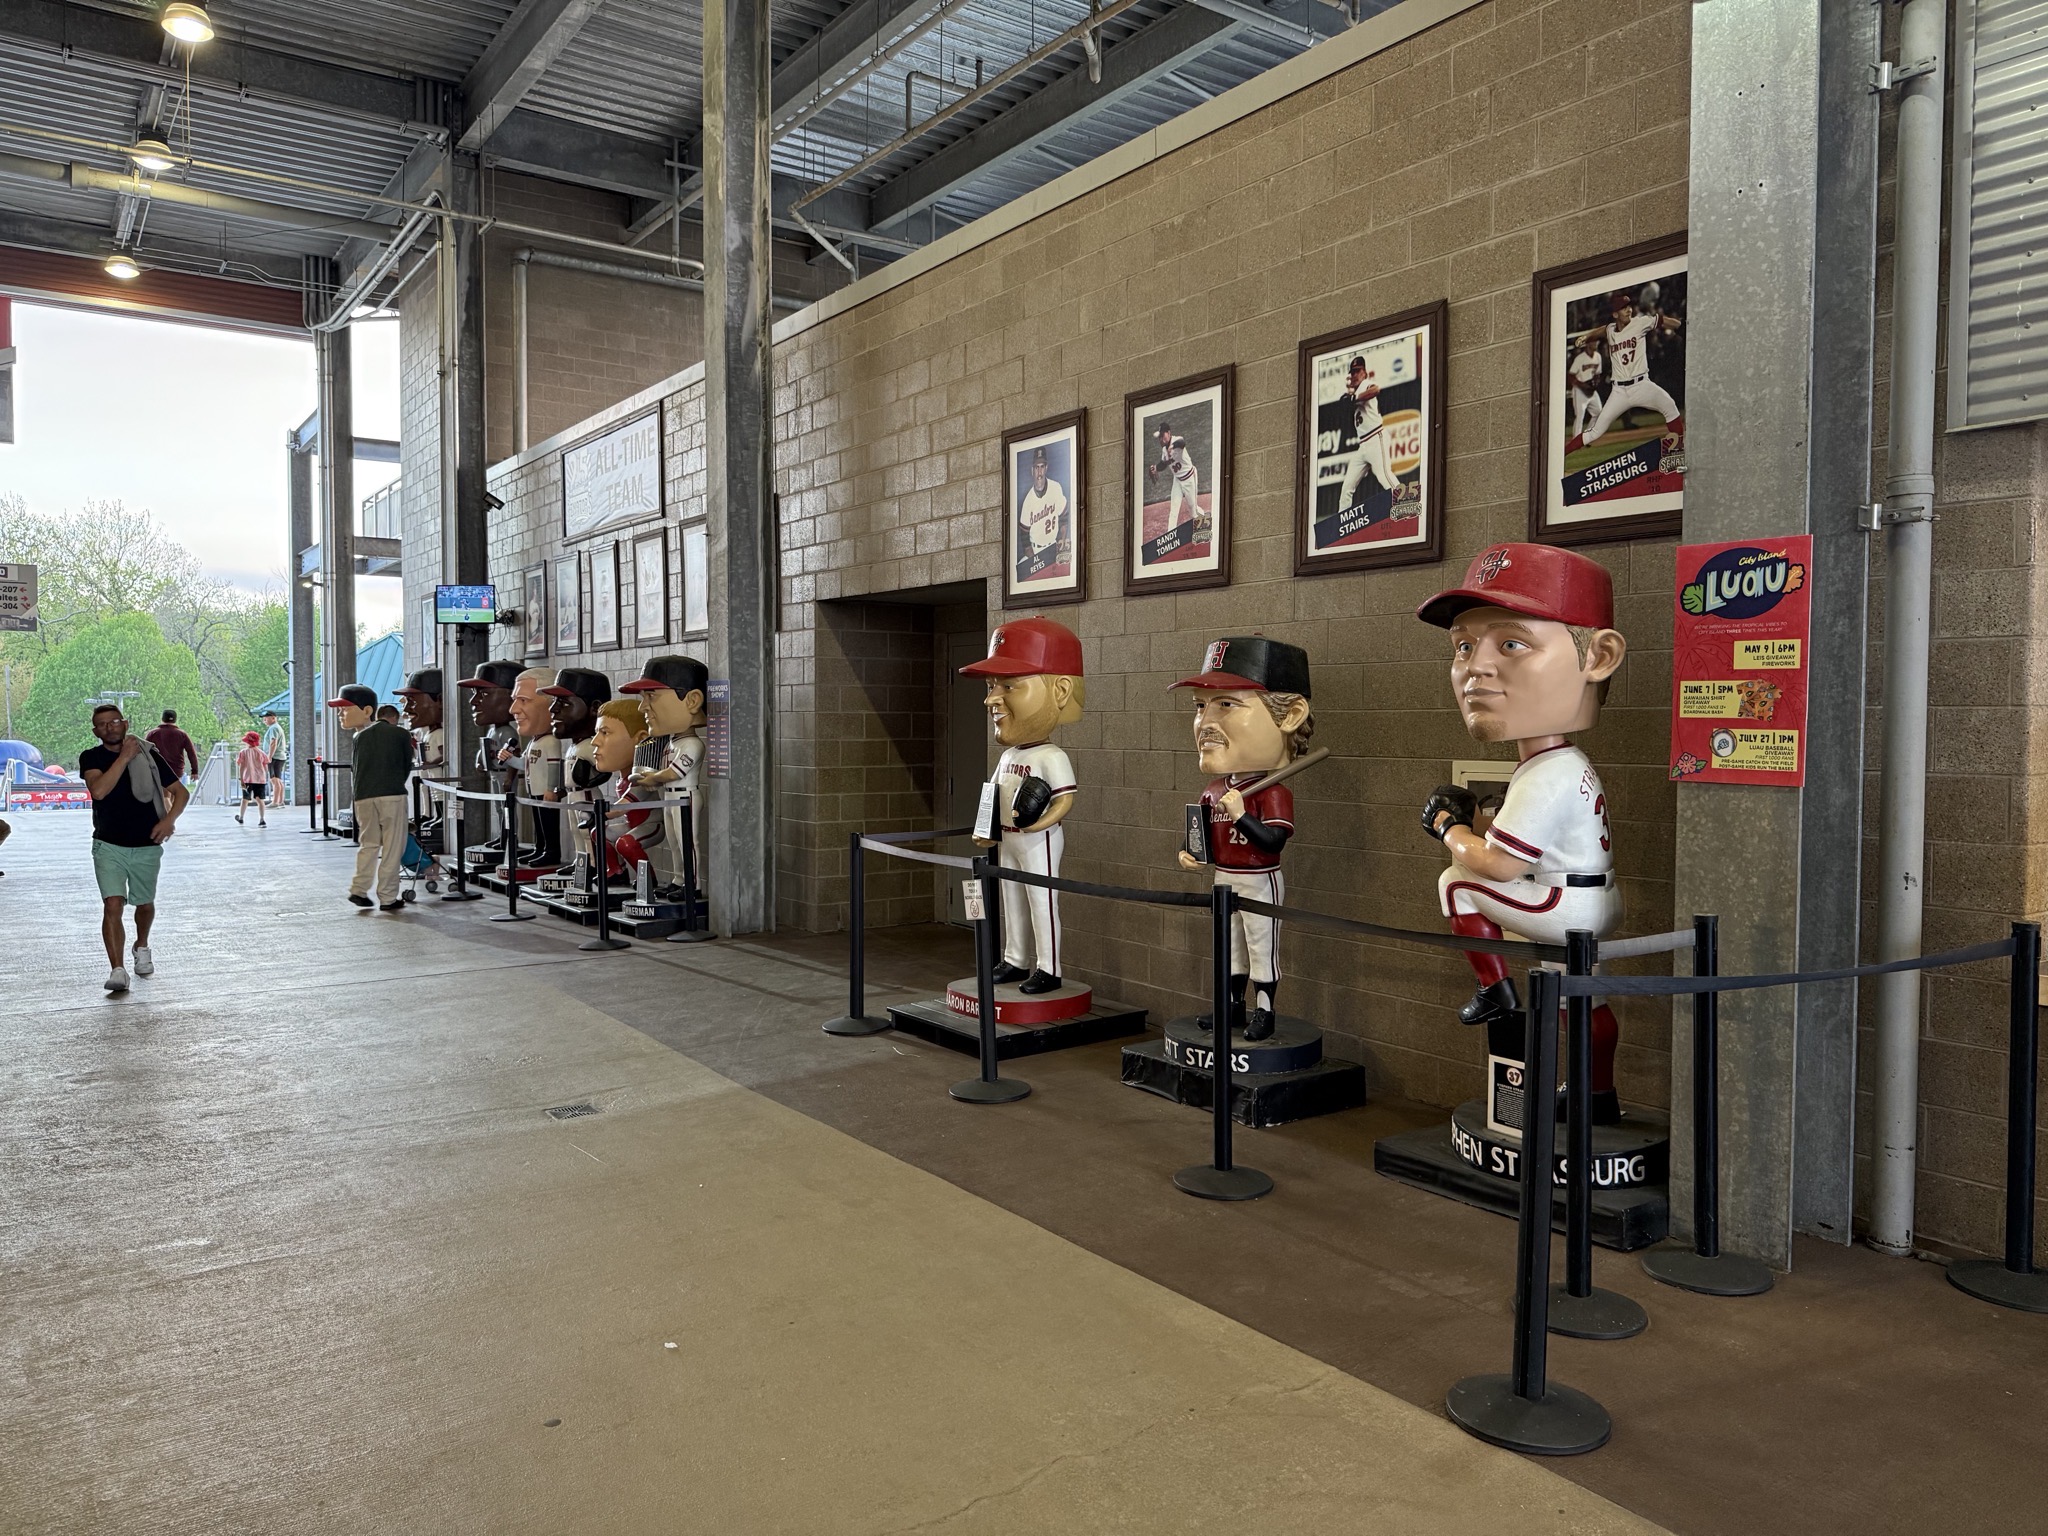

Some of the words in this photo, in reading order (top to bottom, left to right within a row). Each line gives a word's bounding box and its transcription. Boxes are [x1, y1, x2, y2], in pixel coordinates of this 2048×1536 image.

[1621, 350, 1636, 366] 37
[595, 425, 656, 478] ALL-TIME
[1389, 438, 1419, 460] ING
[1585, 451, 1637, 481] STEPHEN
[1660, 457, 1685, 472] SENAT
[1580, 461, 1648, 498] STRASBURG
[606, 473, 644, 514] TEAM
[1340, 504, 1365, 524] MATT
[1339, 515, 1370, 537] STAIRS
[1156, 529, 1178, 547] RANDY
[1156, 538, 1180, 556] TOMLIN
[1033, 555, 1040, 564] AL
[1738, 555, 1757, 566] City
[1758, 548, 1787, 562] Island
[1030, 560, 1045, 574] REYES
[1744, 645, 1760, 653] MAY
[1764, 645, 1769, 653] 9
[1778, 644, 1795, 652] 6PM
[1683, 685, 1703, 694] JUNE
[1706, 685, 1710, 693] 7
[1718, 685, 1734, 694] 5PM
[1739, 734, 1758, 743] JULY
[1760, 735, 1769, 743] 27
[1779, 735, 1794, 743] 1PM
[1210, 808, 1233, 824] Sena
[1229, 827, 1248, 845] 25
[544, 880, 575, 890] PHILLIP
[965, 999, 1002, 1020] BART
[1165, 1036, 1179, 1059] ATT
[1185, 1047, 1250, 1073] STARS
[1508, 1070, 1521, 1084] 37
[1451, 1115, 1483, 1166] PHEN
